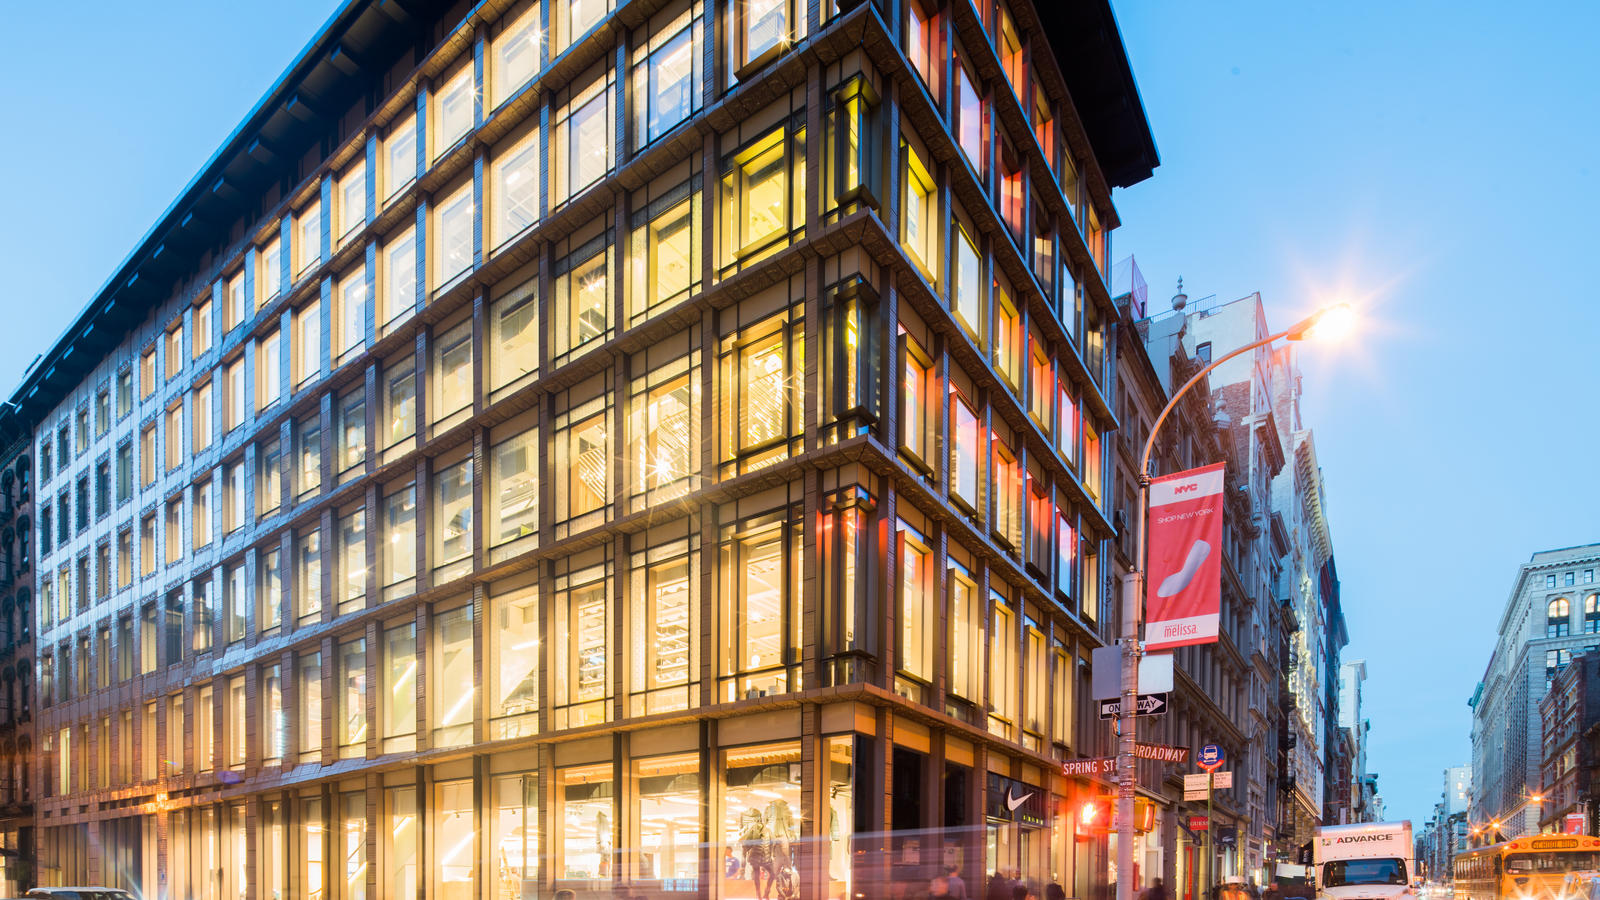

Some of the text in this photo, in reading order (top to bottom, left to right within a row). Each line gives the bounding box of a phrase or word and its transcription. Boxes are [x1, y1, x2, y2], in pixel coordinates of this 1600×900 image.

[1174, 483, 1198, 495] NYC
[1158, 507, 1214, 524] SHOP NEW YORK
[1108, 700, 1157, 713] ON WAY
[1063, 759, 1115, 775] SPRING ST
[1336, 833, 1393, 844] ADVANCE
[1532, 840, 1558, 849] SCHOOL
